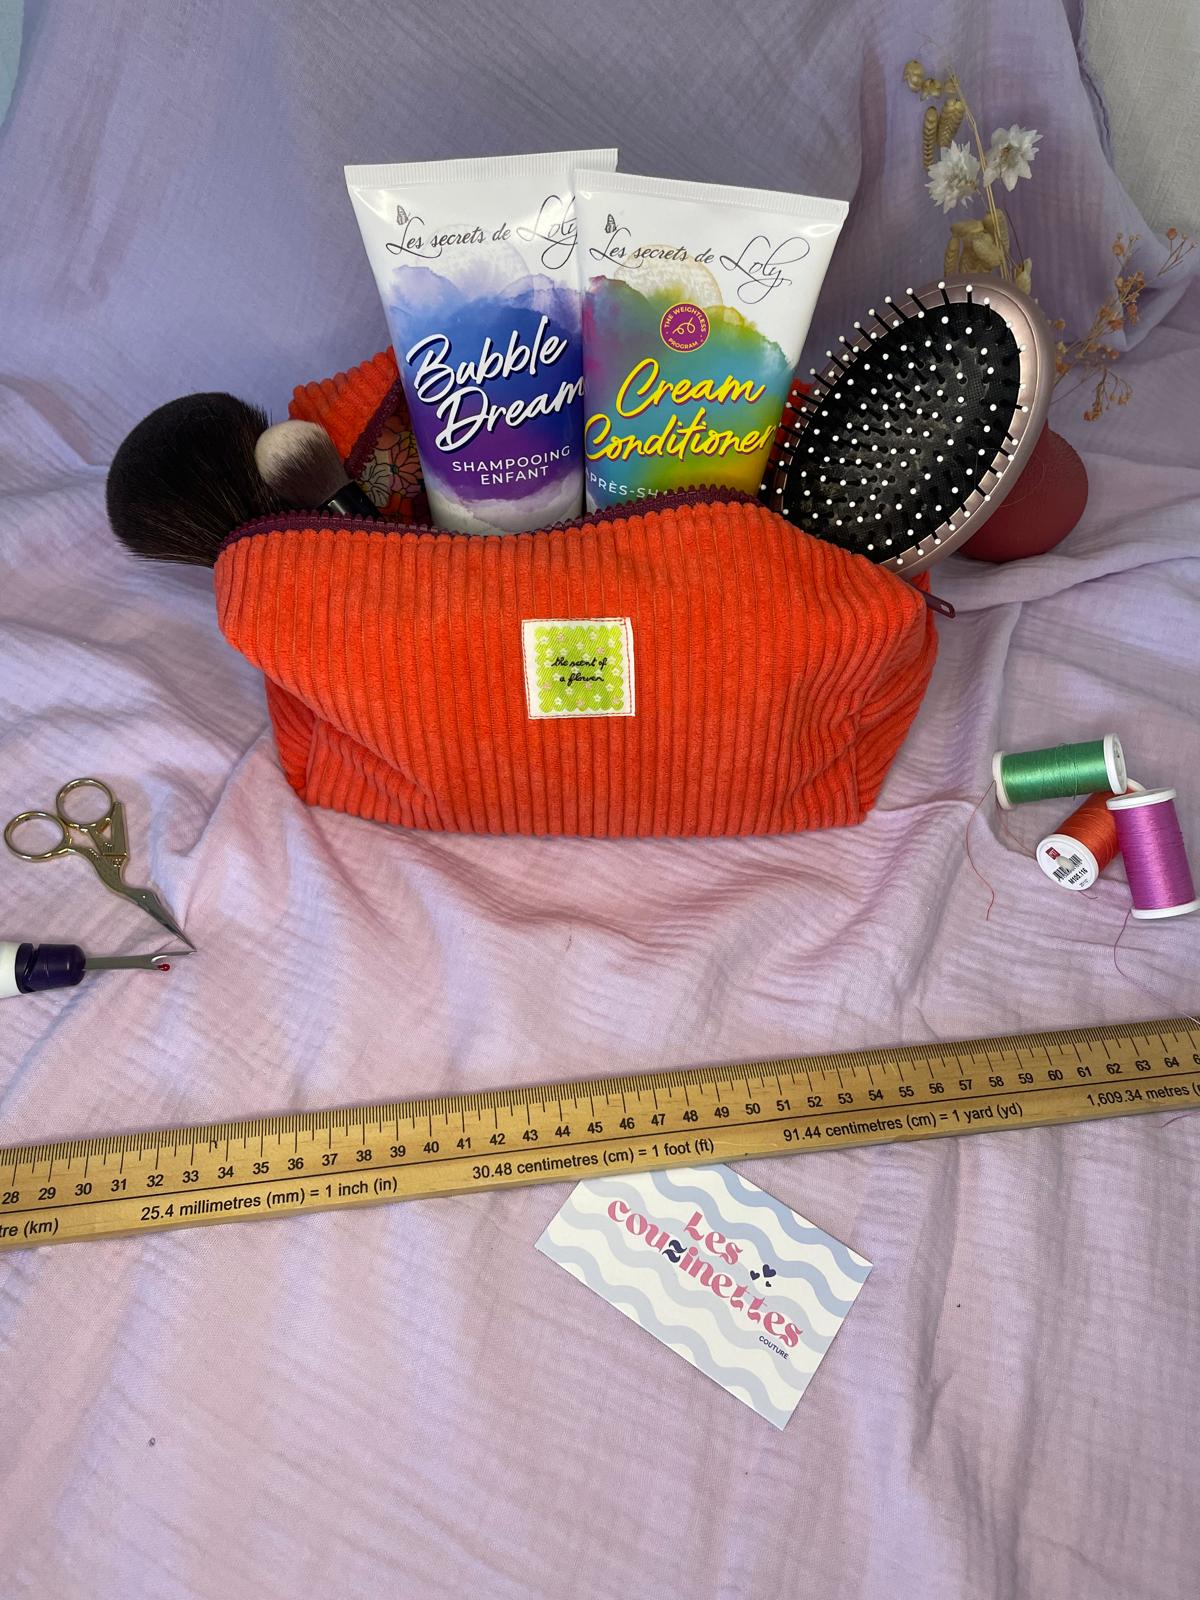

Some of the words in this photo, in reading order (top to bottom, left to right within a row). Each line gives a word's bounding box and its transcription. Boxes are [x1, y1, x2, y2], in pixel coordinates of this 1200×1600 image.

[386, 217, 442, 258] Les
[430, 226, 486, 247] secrets
[491, 222, 512, 242] de
[589, 227, 643, 269] Les
[633, 246, 689, 262] secrets
[694, 247, 715, 264] de
[719, 235, 811, 304] Loly
[664, 313, 674, 328] THE
[673, 306, 707, 332] WEIGHTLESS
[405, 315, 568, 403] Bubble
[668, 337, 699, 349] PROGRAM
[616, 358, 766, 418] Cream
[435, 376, 586, 453] Dream
[584, 406, 777, 462] Conditioner
[452, 445, 571, 472] SHAMPOOING
[480, 465, 549, 485] ENFANT
[551, 657, 568, 667] the
[598, 657, 608, 670] of
[1086, 1088, 1143, 1109] 1,609.34
[1145, 1085, 1190, 1100] metres
[2, 1191, 20, 1205] 28
[38, 1187, 57, 1200] 29
[75, 1182, 93, 1196] 30
[110, 1178, 128, 1192] 31
[146, 1174, 164, 1187] 32
[182, 1170, 199, 1183] 33
[217, 1166, 235, 1179] 34
[252, 1161, 270, 1175] 35
[287, 1157, 304, 1171] 36
[321, 1153, 338, 1166] 37
[356, 1149, 372, 1162] 38
[389, 1145, 406, 1158] 39
[423, 1141, 440, 1154] 40
[456, 1137, 472, 1150] 41
[489, 1133, 506, 1146] 42
[522, 1129, 539, 1142] 43
[554, 1125, 571, 1138] 44
[587, 1121, 604, 1134] 45
[619, 1117, 635, 1130] 46
[651, 1113, 667, 1126] 47
[682, 1109, 699, 1123] 48
[714, 1106, 730, 1119] 49
[745, 1102, 761, 1115] 50
[776, 1099, 791, 1112] 51
[807, 1095, 823, 1108] 52
[837, 1092, 854, 1105] 53
[868, 1089, 884, 1102] 54
[899, 1085, 915, 1098] 55
[929, 1082, 945, 1095] 56
[959, 1079, 973, 1091] 57
[989, 1076, 1004, 1088] 58
[1018, 1072, 1034, 1085] 59
[1048, 1069, 1063, 1082] 60
[1077, 1066, 1092, 1078] 61
[1106, 1063, 1122, 1075] 62
[1135, 1059, 1151, 1072] 63
[1164, 1056, 1180, 1068] 64
[783, 1125, 822, 1142] 91.44
[825, 1115, 903, 1138] centimetres
[906, 1112, 937, 1131] (cm)
[940, 1112, 949, 1121] =
[952, 1109, 960, 1123] 1
[964, 1105, 994, 1124] yard
[996, 1101, 1024, 1119] (yd)
[472, 1163, 513, 1180] 30.48
[517, 1152, 599, 1174] centimetres
[603, 1147, 635, 1167] (cm)
[638, 1149, 647, 1157] =
[652, 1144, 659, 1158] 1
[664, 1141, 692, 1156] foot
[695, 1138, 715, 1156] (ft)
[140, 1204, 175, 1222] 25.4
[179, 1195, 261, 1217] millimetres
[266, 1188, 305, 1209] (mm)
[309, 1189, 320, 1198] =
[326, 1184, 332, 1198] 1
[338, 1180, 368, 1196] inch
[373, 1176, 398, 1195] (in)
[23, 1216, 59, 1239] (km)
[684, 1210, 743, 1265] Les
[607, 1200, 803, 1348] couzinettes
[758, 1335, 790, 1360] COUTURE
